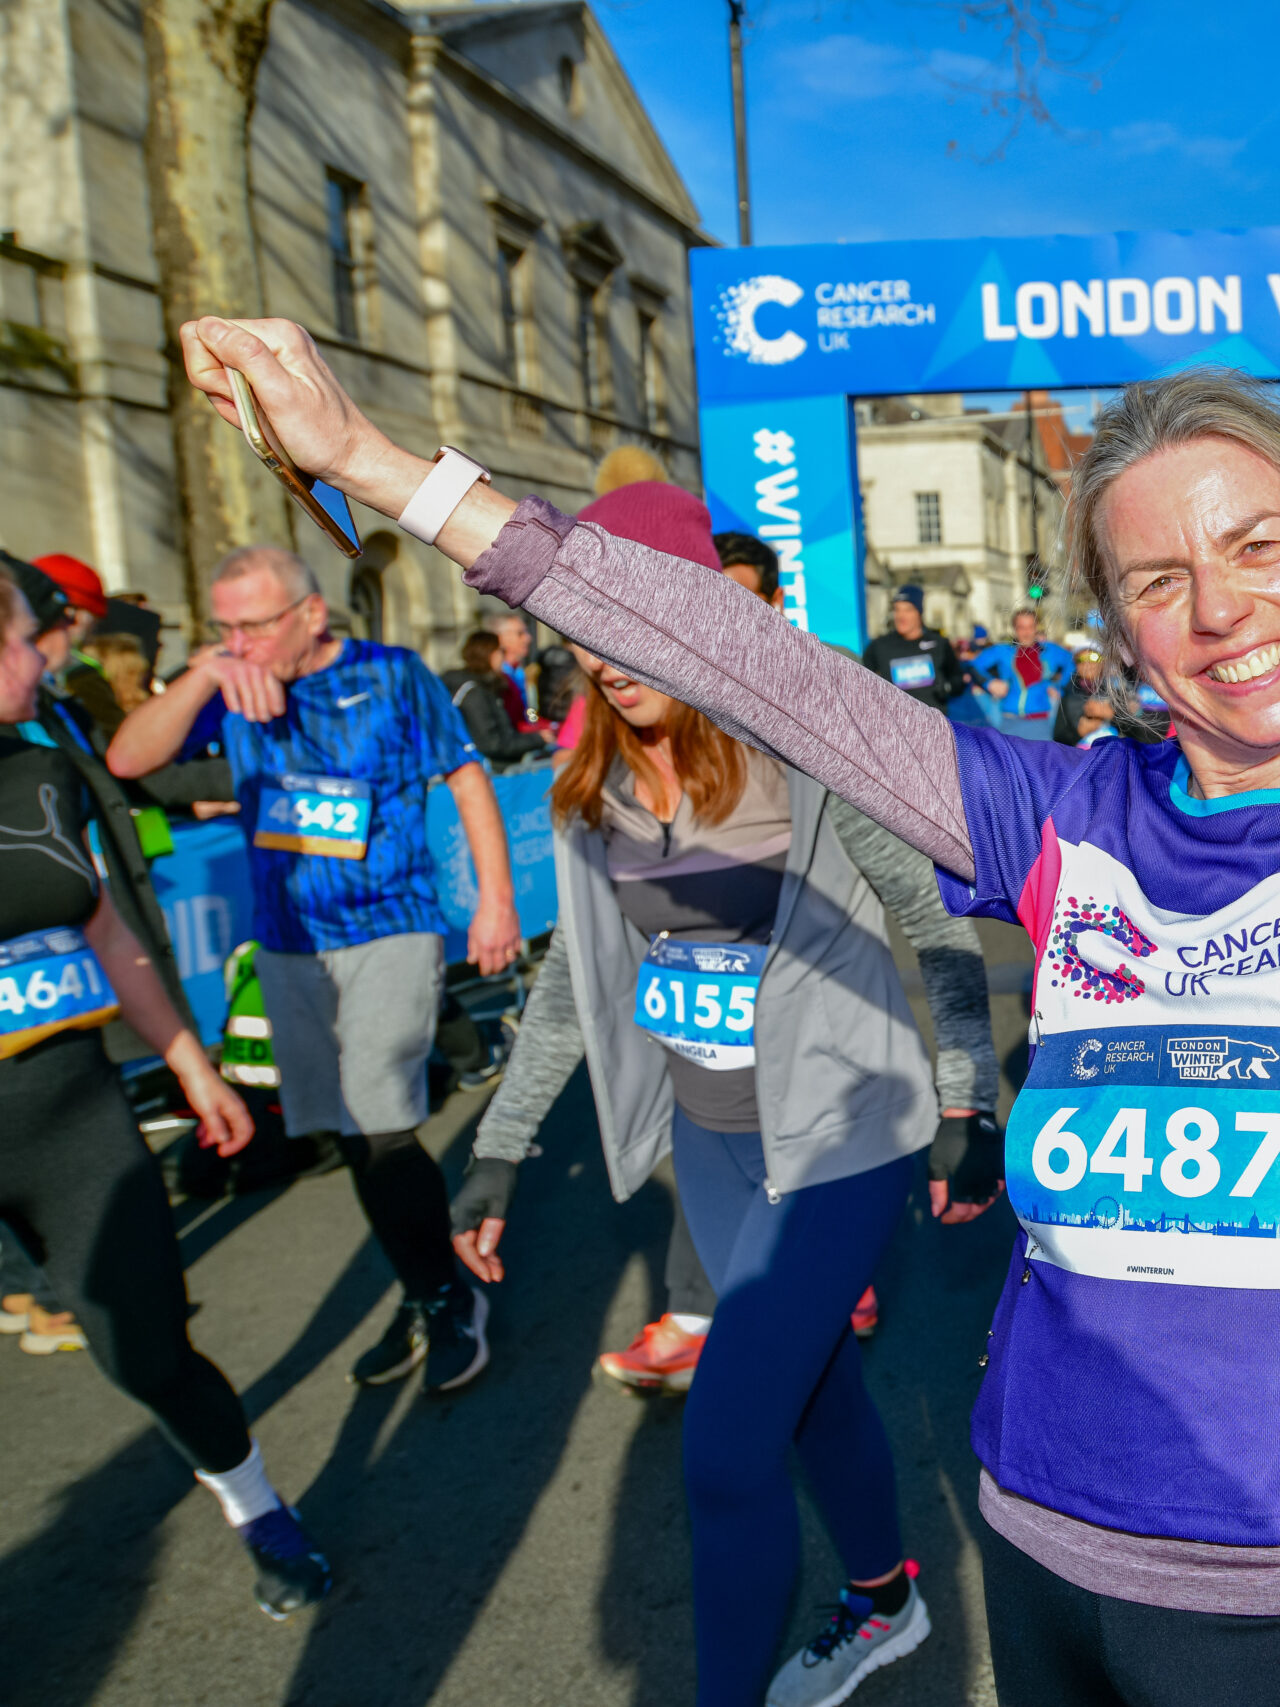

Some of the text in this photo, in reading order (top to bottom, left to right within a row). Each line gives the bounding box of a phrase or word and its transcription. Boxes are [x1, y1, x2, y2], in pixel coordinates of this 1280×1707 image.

[815, 279, 911, 306] CANCER
[816, 302, 936, 329] RESEARCH
[980, 275, 1242, 341] LONDON
[817, 331, 851, 354] UK
[0, 958, 102, 1015] 4641
[1164, 971, 1211, 997] UK
[644, 976, 755, 1032] 6155
[675, 1043, 717, 1059] ANGELA
[1107, 1040, 1146, 1052] CANCER
[1174, 1041, 1221, 1051] LONDON
[1105, 1052, 1154, 1063] RESEARCH
[1173, 1052, 1221, 1067] WINTER
[1103, 1063, 1117, 1074] UK
[1182, 1066, 1209, 1078] RUN
[1126, 1265, 1175, 1276] #WINTERRUN
